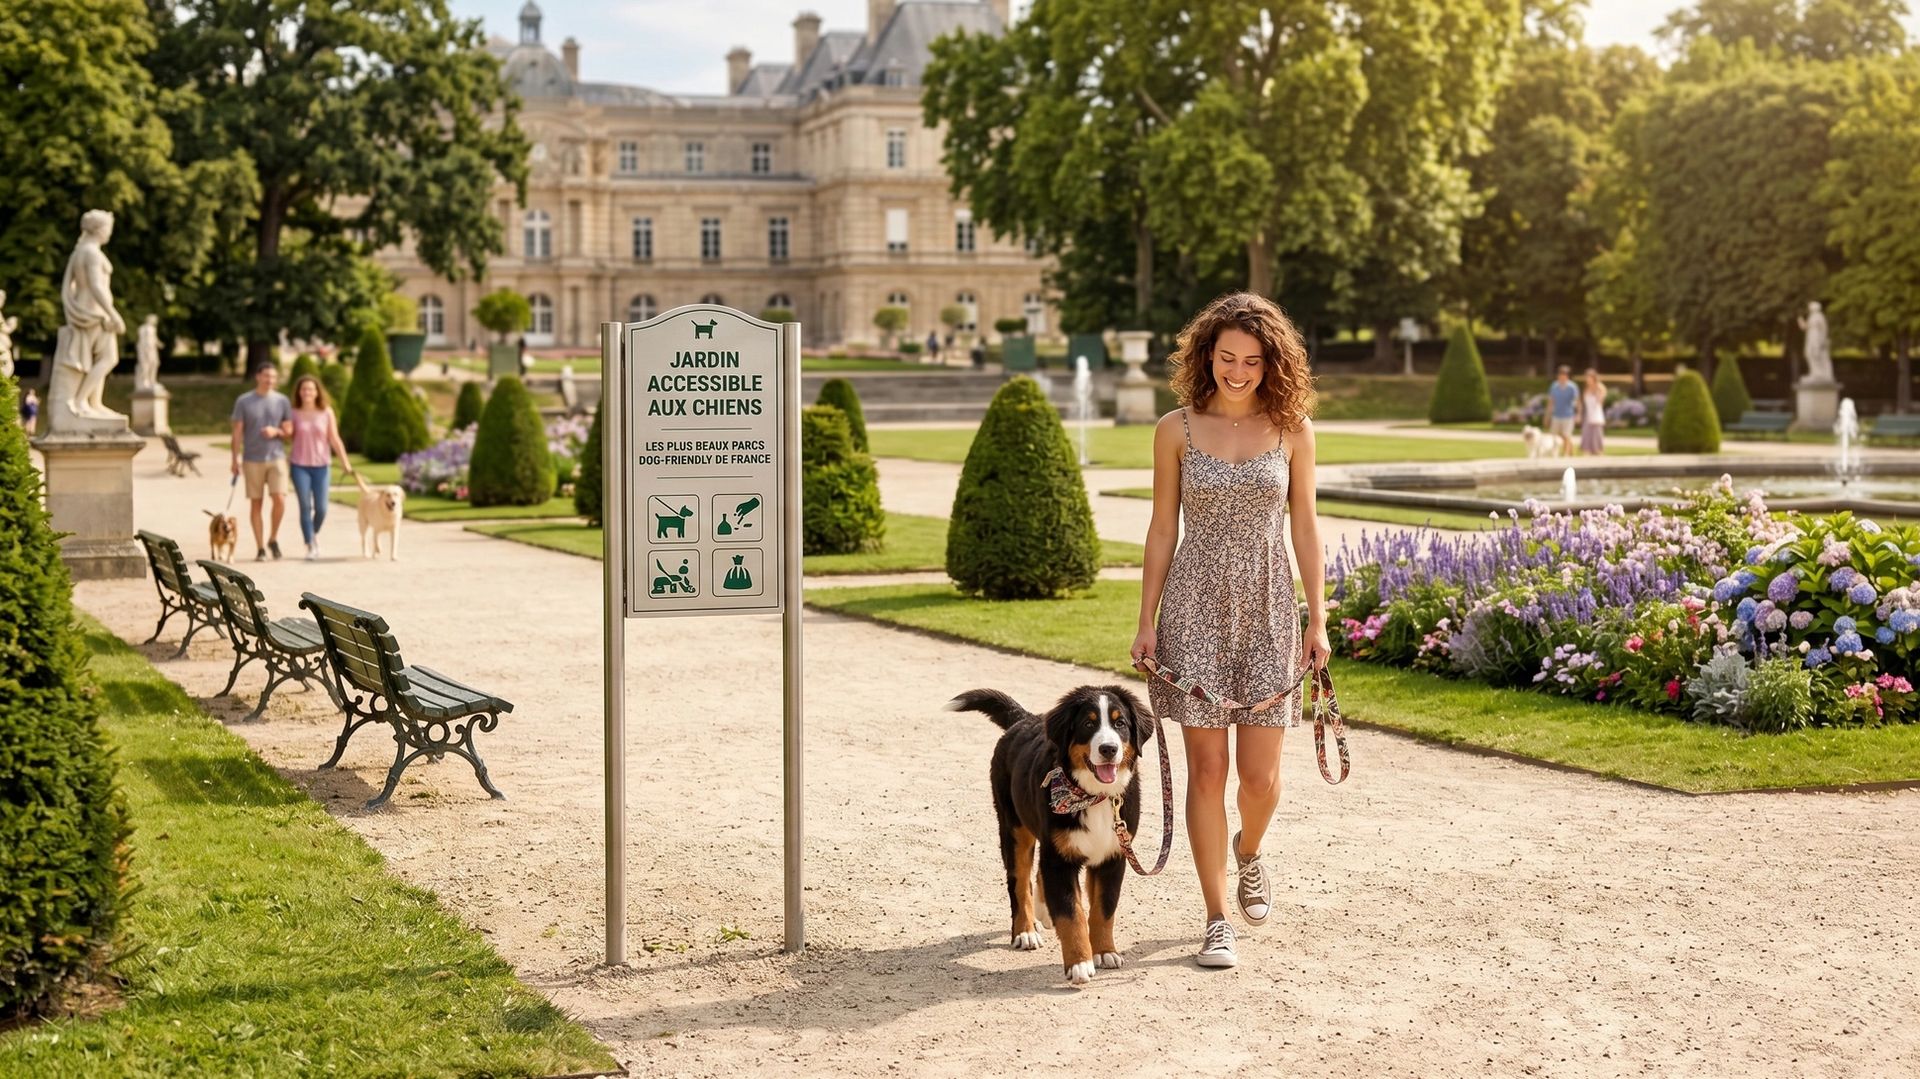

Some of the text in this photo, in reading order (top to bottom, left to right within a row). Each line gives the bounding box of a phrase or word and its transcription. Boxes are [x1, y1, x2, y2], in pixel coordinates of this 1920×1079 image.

[670, 351, 740, 368] JARDIN
[647, 375, 763, 392] ACCESSIBLE
[647, 398, 763, 416] AUX CHIENS
[645, 440, 765, 452] LES PLUS BEAUX PARCS
[639, 454, 771, 465] DOG-FRIENDLY DE FRANCE
